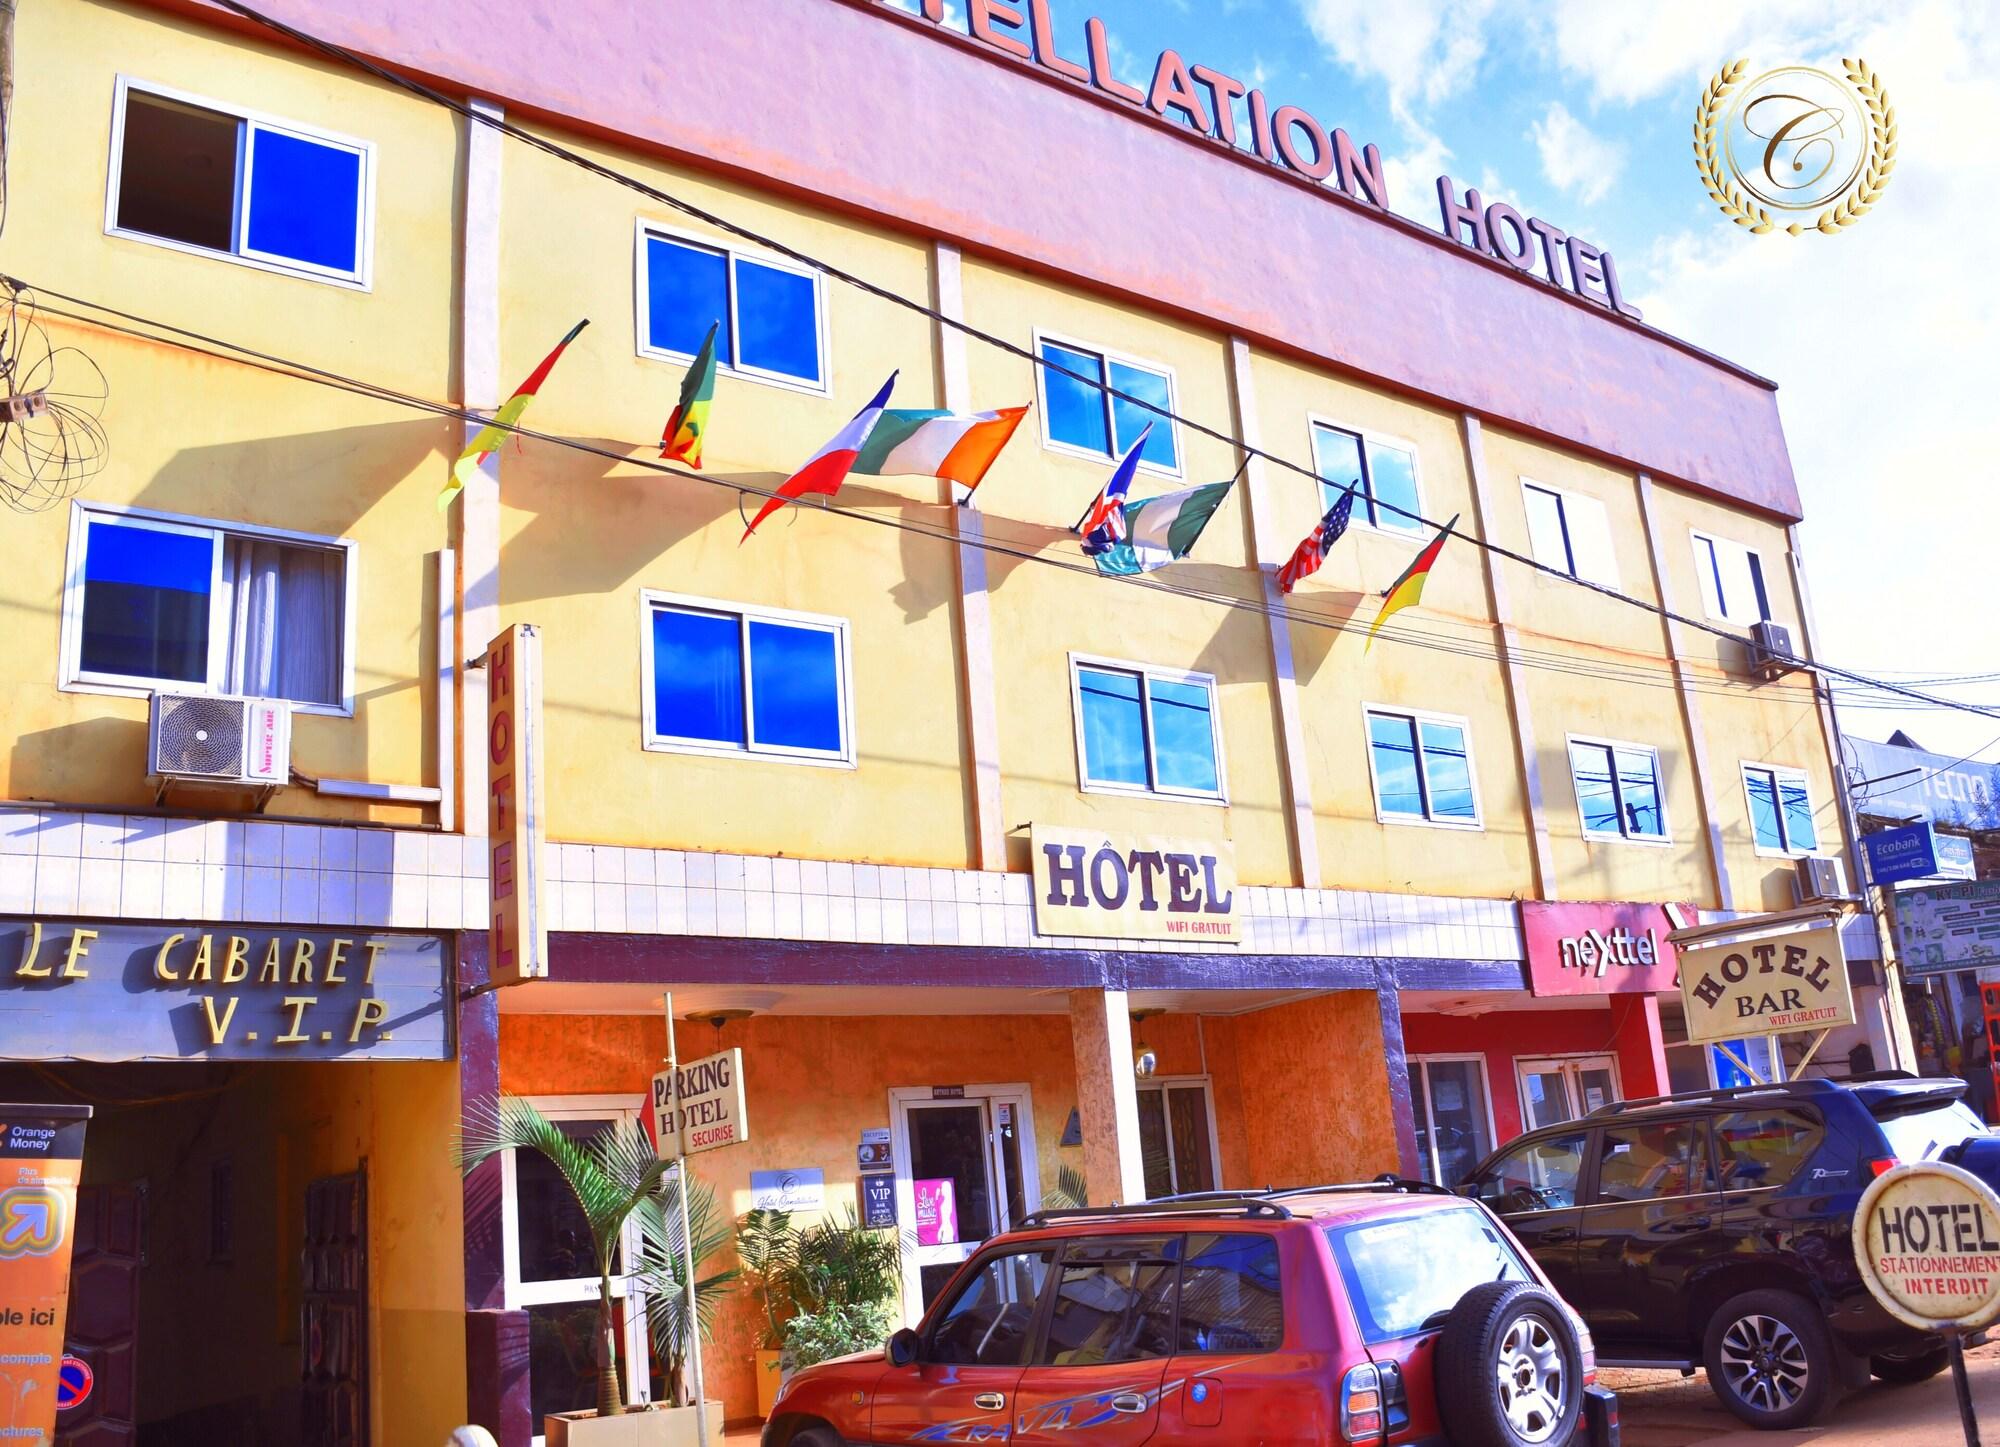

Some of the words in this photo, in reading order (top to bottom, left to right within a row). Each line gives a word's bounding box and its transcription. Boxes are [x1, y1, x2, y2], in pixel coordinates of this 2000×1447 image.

[1436, 174, 1645, 321] HOTEL
[489, 641, 517, 968] HOTEL
[1877, 837, 1921, 856] Ecobank
[1042, 840, 1232, 914] HÔTEL
[1166, 920, 1190, 933] WIFI
[1192, 922, 1232, 935] GRATUIT
[16, 923, 98, 979] LE
[157, 933, 388, 985] CABARET
[1560, 927, 1660, 977] nexttel
[1692, 943, 1831, 1009] HOTEL
[1736, 988, 1806, 1018] BAR
[1769, 1013, 1792, 1026] WIFI
[1794, 1007, 1837, 1024] GRATUIT
[202, 996, 394, 1045] V.I.P.
[653, 1058, 730, 1108] PARKING
[10, 1138, 50, 1151] Money
[12, 1126, 56, 1139] Orange
[692, 1124, 734, 1147] SECURISE
[870, 1187, 891, 1200] VIP
[1879, 1203, 2000, 1253] HOTEL
[1905, 1278, 1989, 1295] INTERDIT
[30, 1308, 55, 1326] ici
